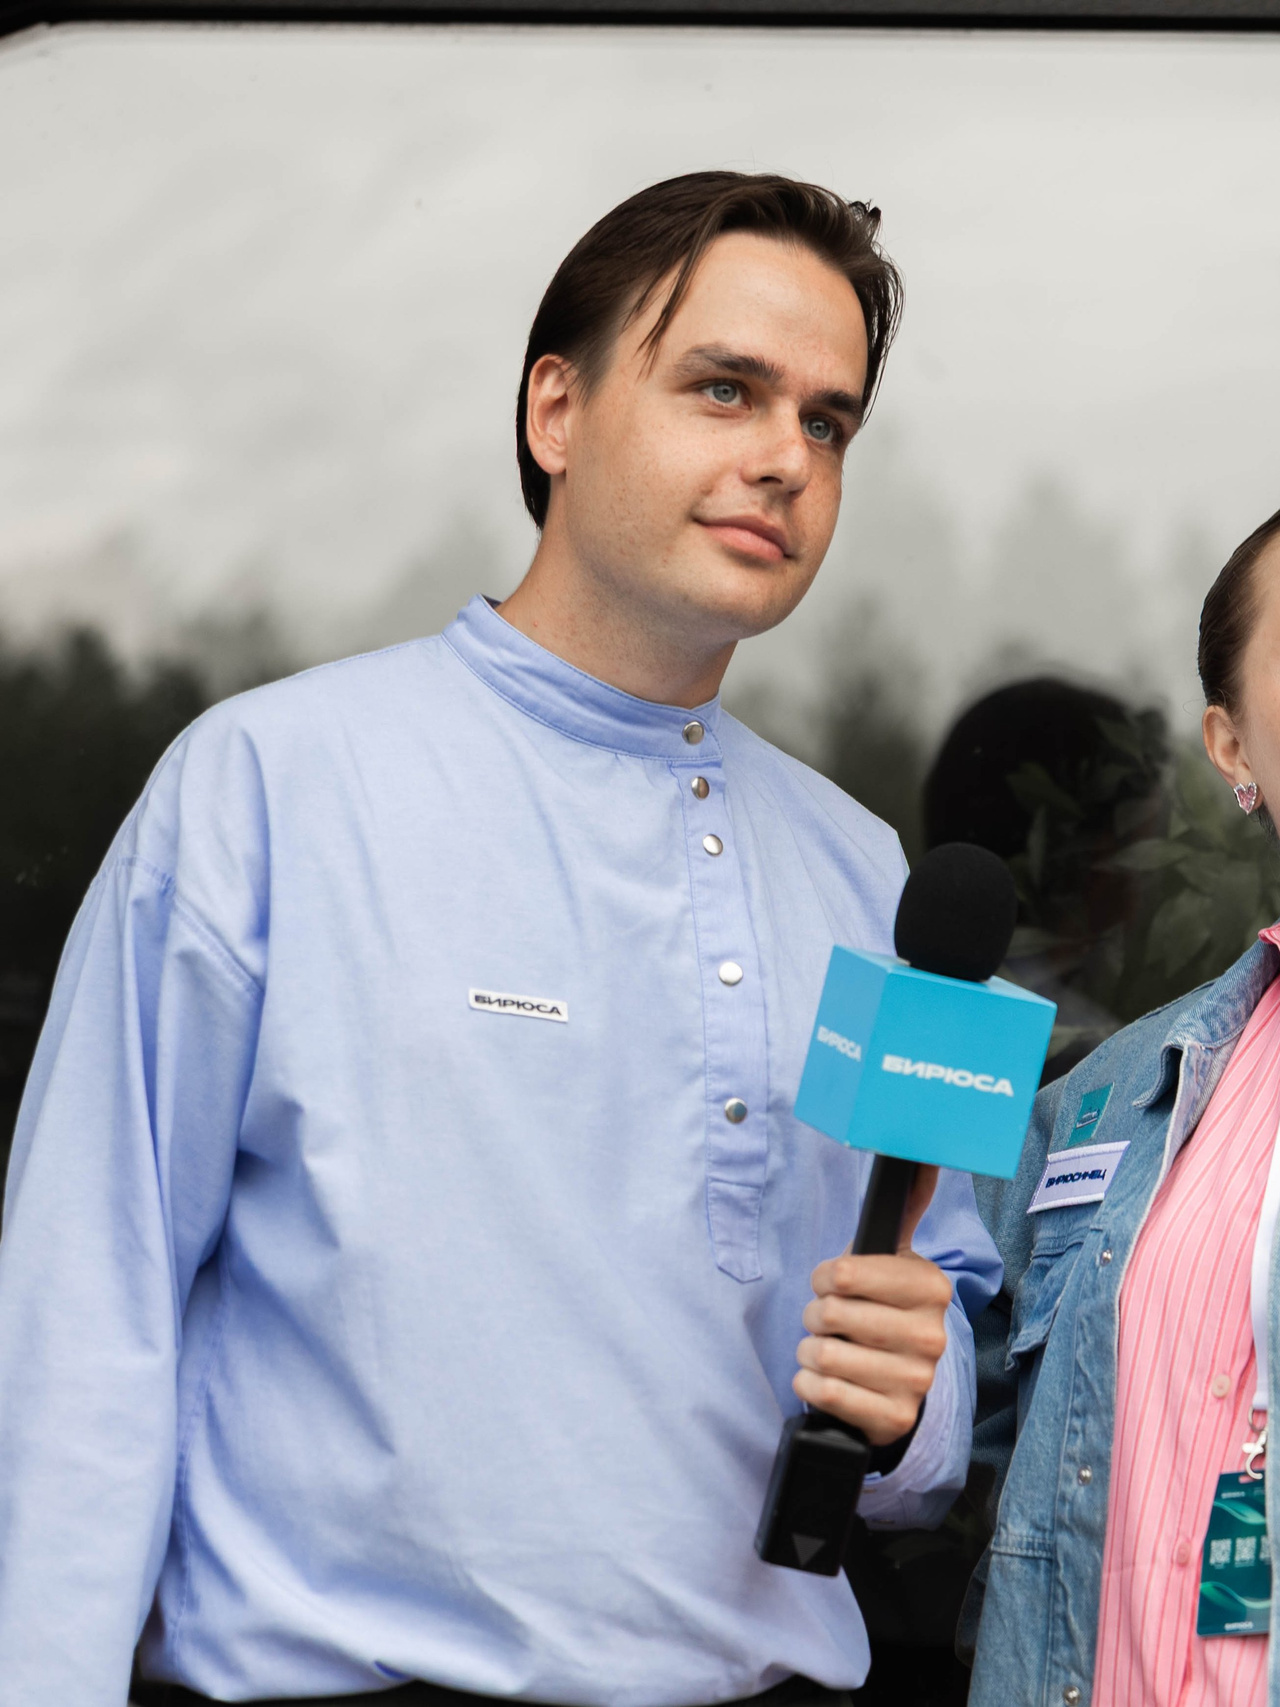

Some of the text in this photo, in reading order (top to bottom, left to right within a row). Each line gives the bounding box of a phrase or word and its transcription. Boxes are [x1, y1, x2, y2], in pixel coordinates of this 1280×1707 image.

[474, 994, 563, 1016] БИРЮСА
[816, 1025, 862, 1063] БИРЮСА
[882, 1054, 1014, 1098] БИРЮСА
